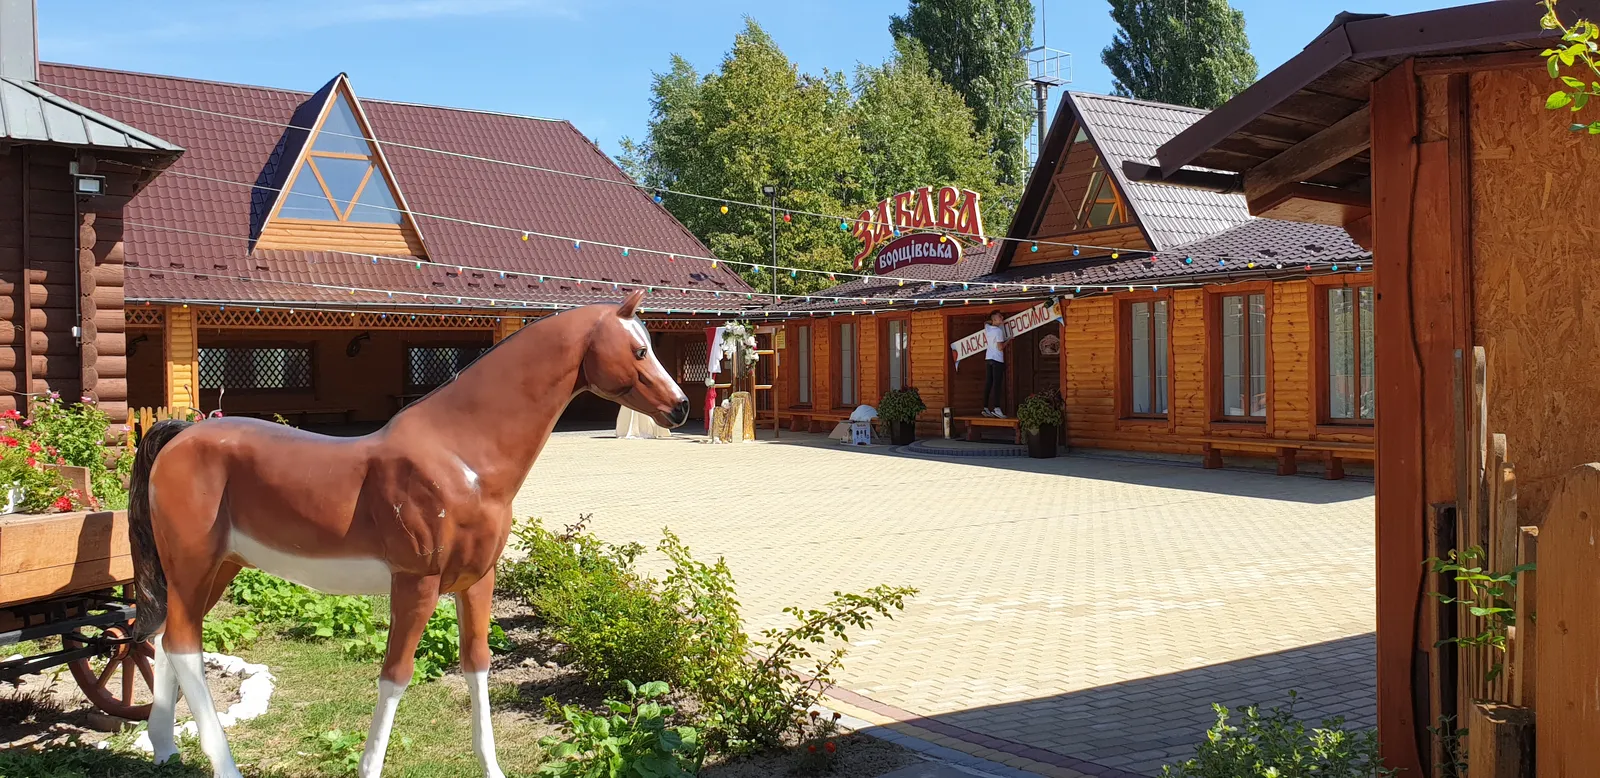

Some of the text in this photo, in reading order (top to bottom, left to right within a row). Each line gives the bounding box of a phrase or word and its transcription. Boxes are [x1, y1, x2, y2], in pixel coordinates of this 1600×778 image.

[853, 186, 987, 270] ЗАБАВА
[961, 306, 1050, 357] ЛАСКА ПРОСИМО
